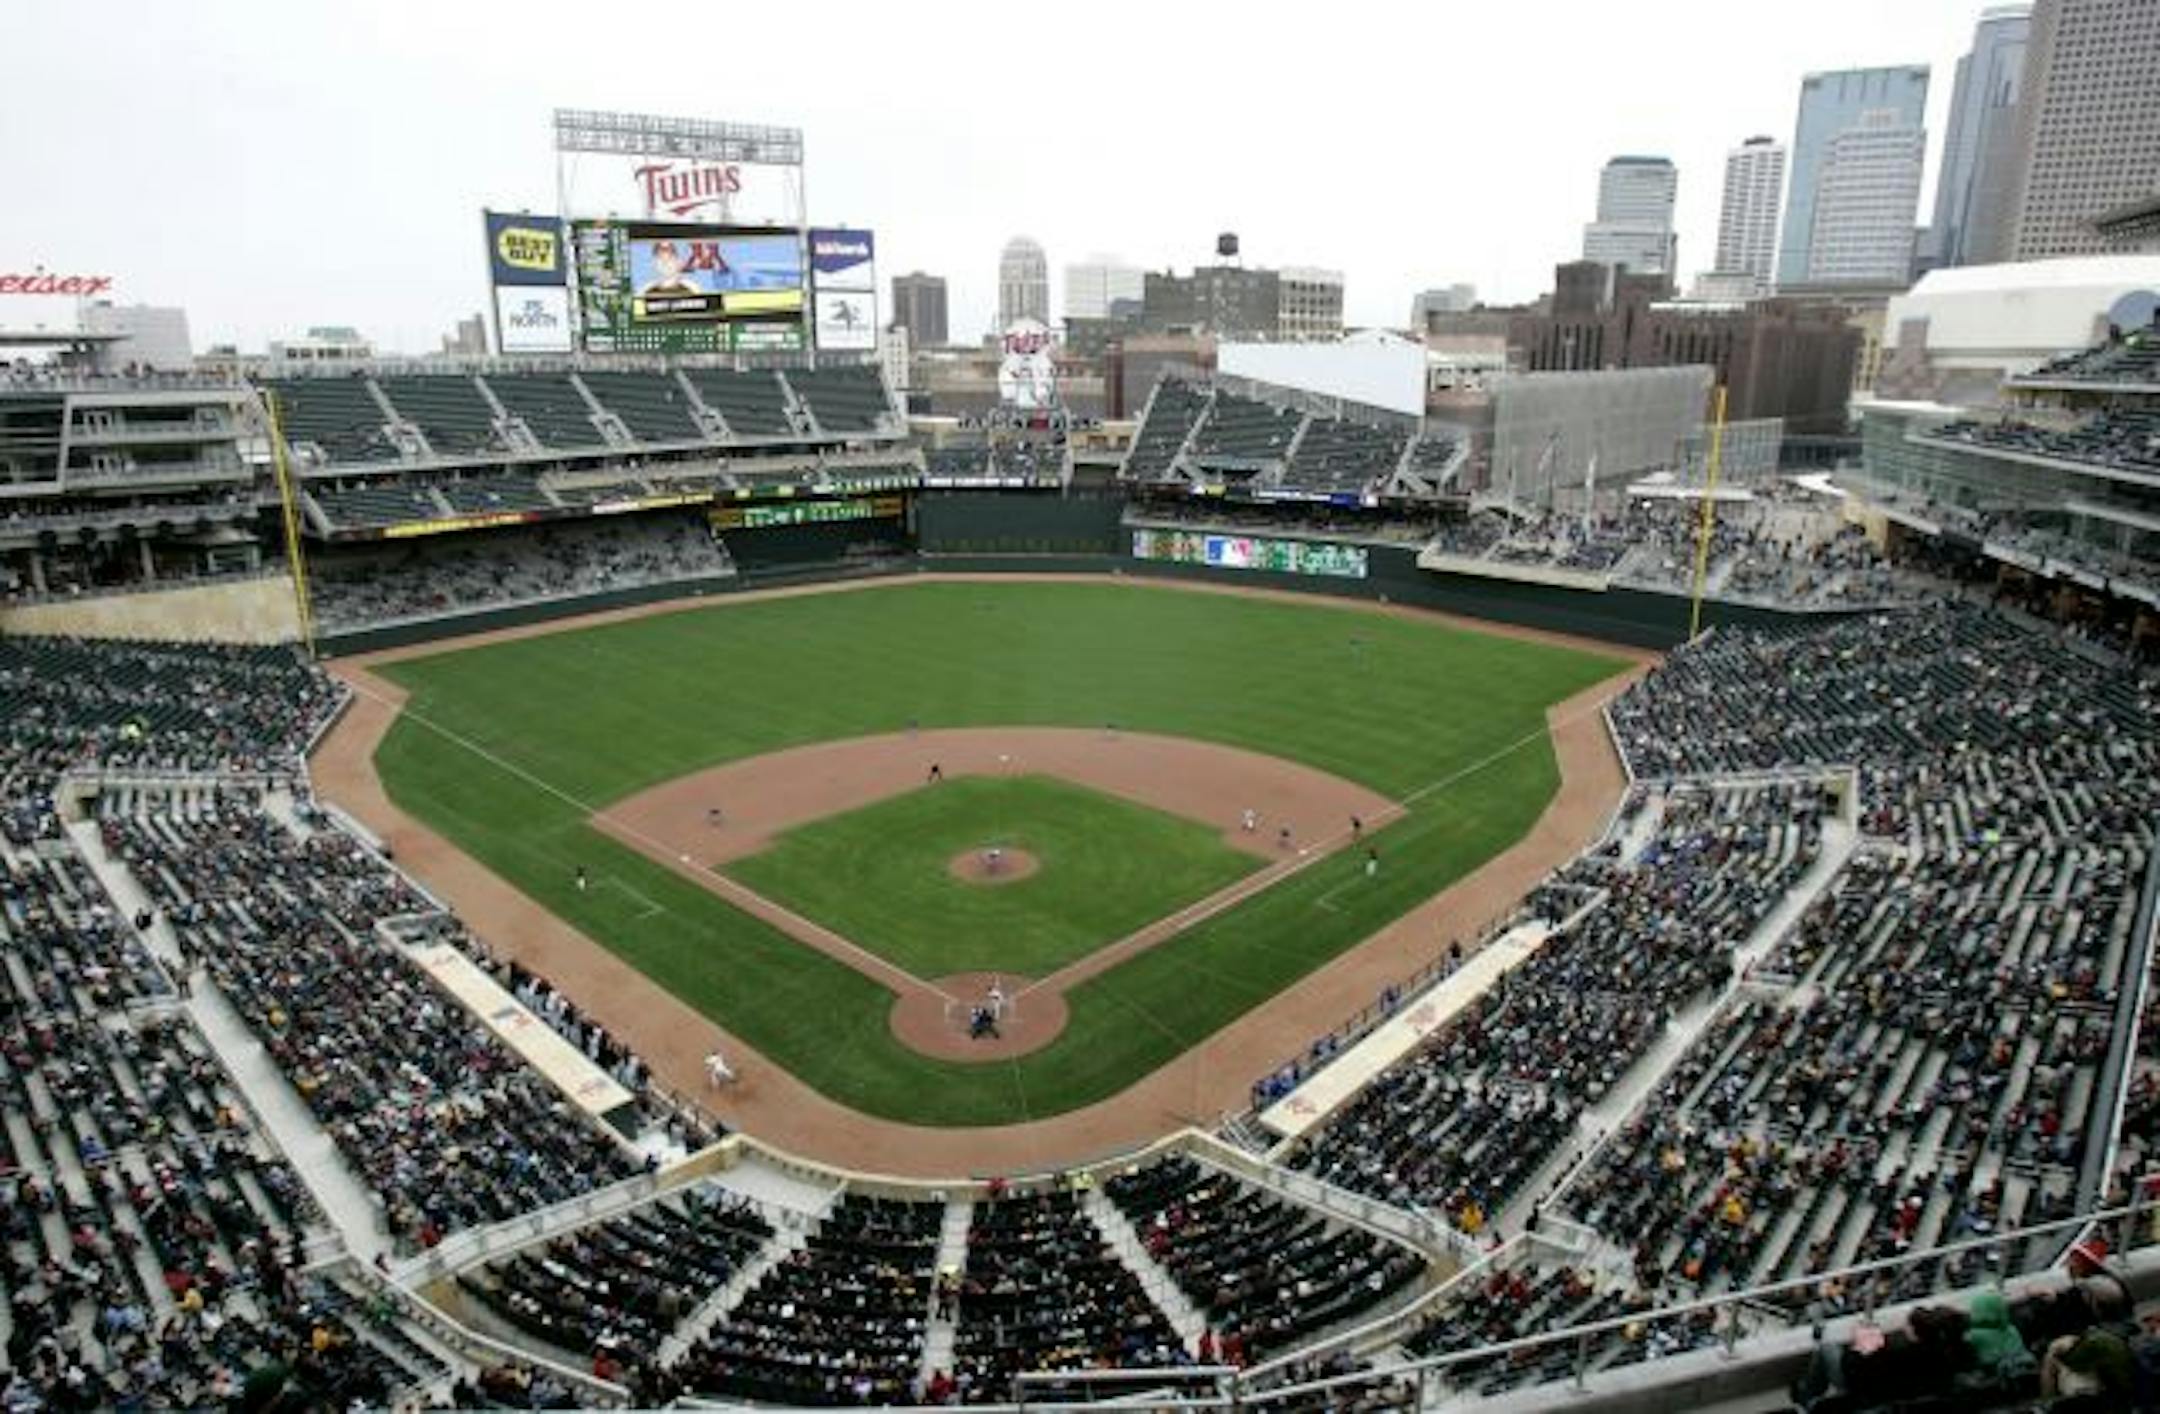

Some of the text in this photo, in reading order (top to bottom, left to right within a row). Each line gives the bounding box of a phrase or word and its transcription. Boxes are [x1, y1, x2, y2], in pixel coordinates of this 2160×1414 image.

[634, 163, 741, 216] Twins
[505, 233, 552, 252] BEST
[509, 248, 548, 264] BUY
